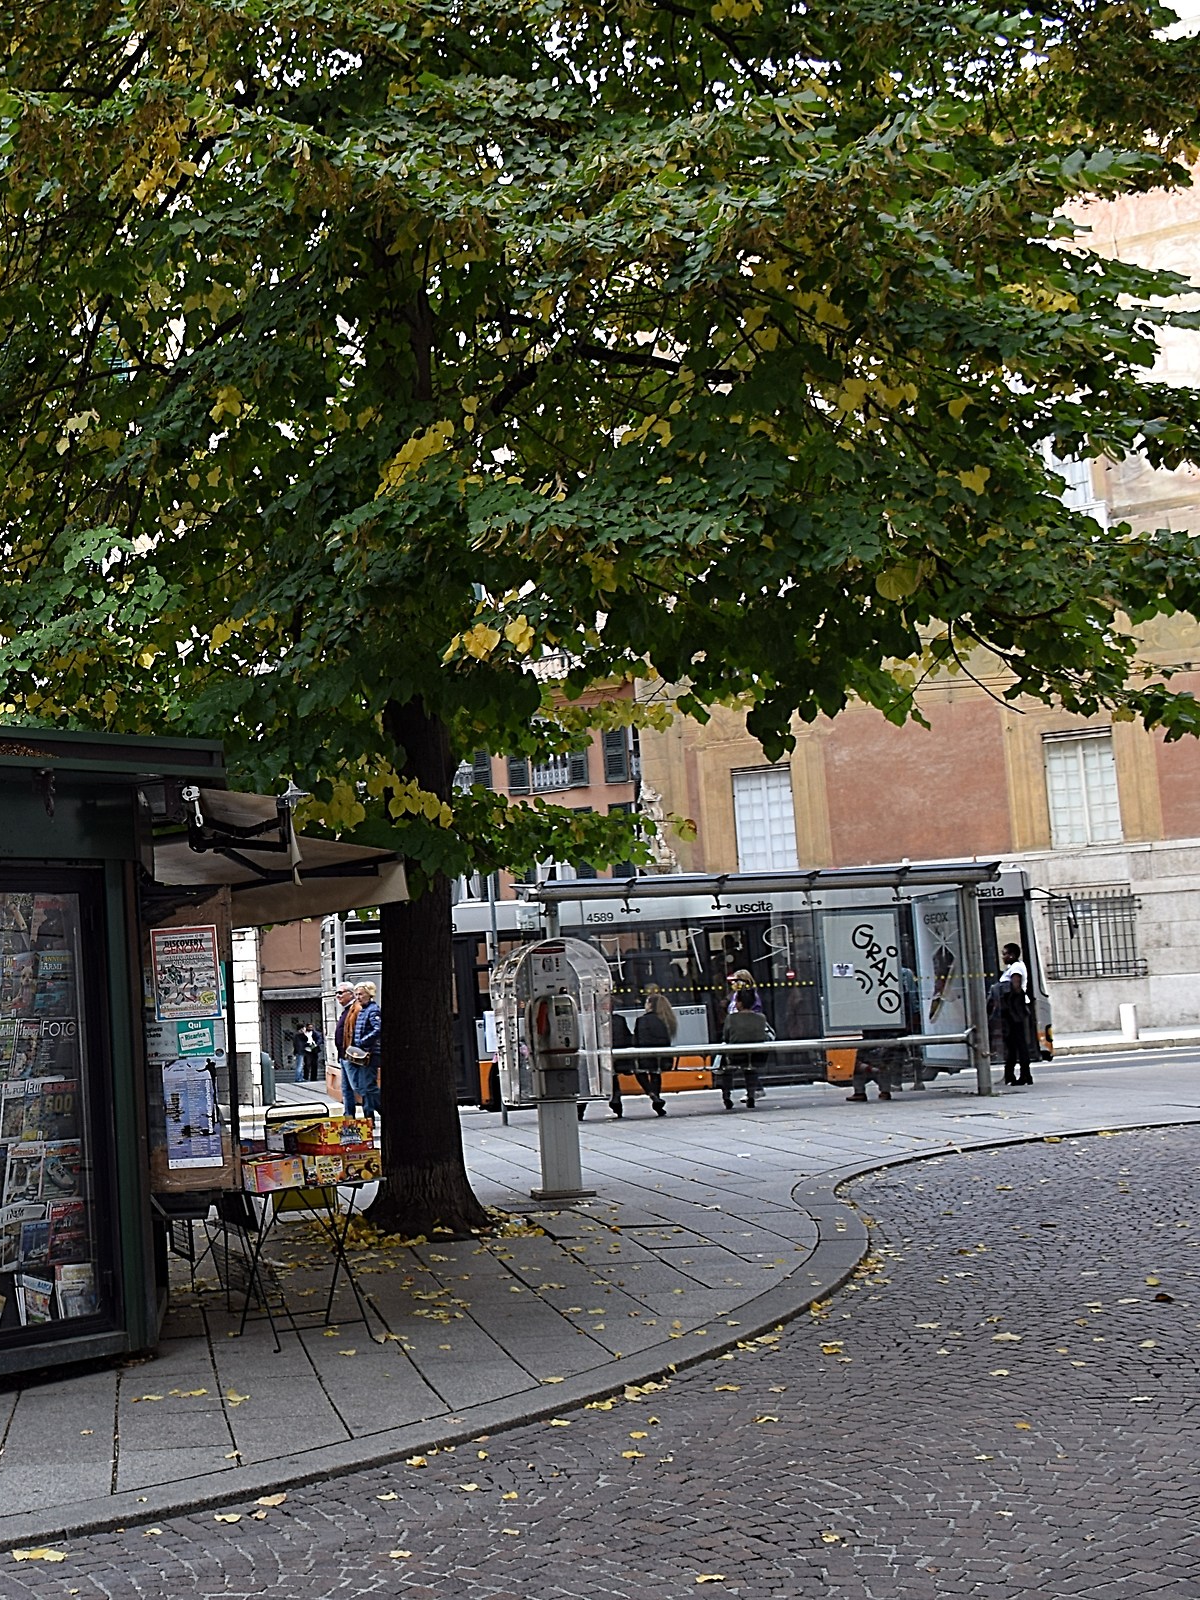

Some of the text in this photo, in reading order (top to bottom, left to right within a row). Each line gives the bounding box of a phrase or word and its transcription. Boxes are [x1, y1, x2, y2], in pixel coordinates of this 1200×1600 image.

[735, 900, 774, 913] uscita
[586, 912, 614, 923] 4589
[924, 912, 949, 925] GEOX
[164, 938, 203, 948] DISCOVERY
[162, 945, 206, 955] GENOVA
[679, 1007, 706, 1016] uscita
[188, 1021, 202, 1030] Qui
[185, 1031, 207, 1041] Ricarica
